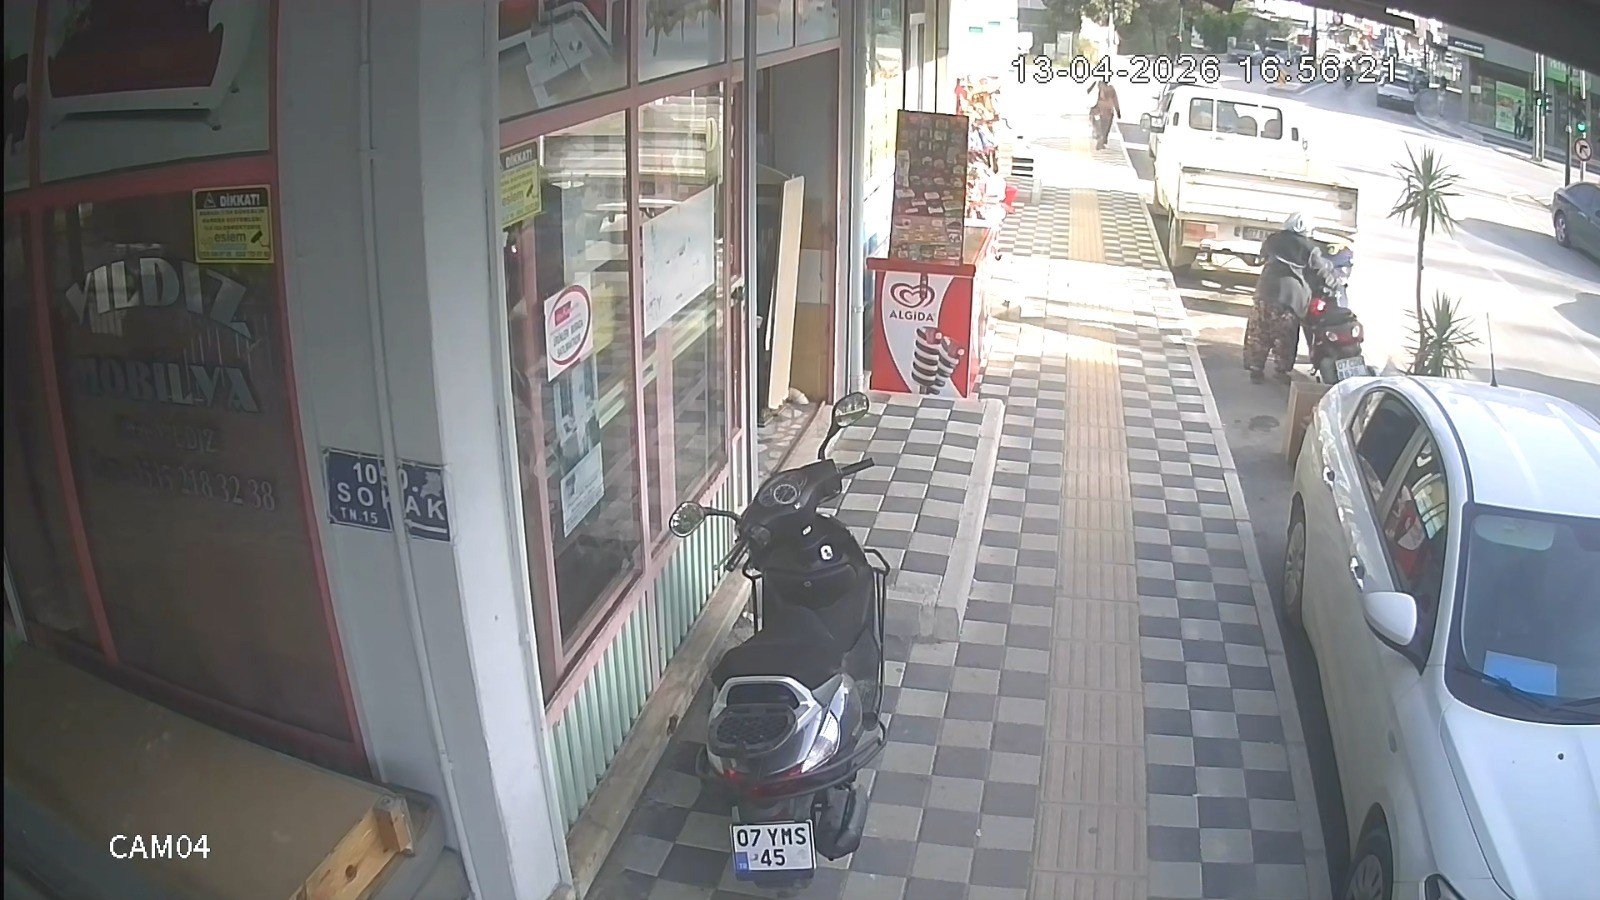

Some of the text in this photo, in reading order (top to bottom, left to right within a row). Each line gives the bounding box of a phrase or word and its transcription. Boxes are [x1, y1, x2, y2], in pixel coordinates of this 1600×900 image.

[219, 193, 260, 207] DİKKAT!
[216, 472, 244, 506] 32
[247, 478, 277, 513] 38
[737, 827, 807, 847] 07 YMS
[760, 848, 786, 866] 45
